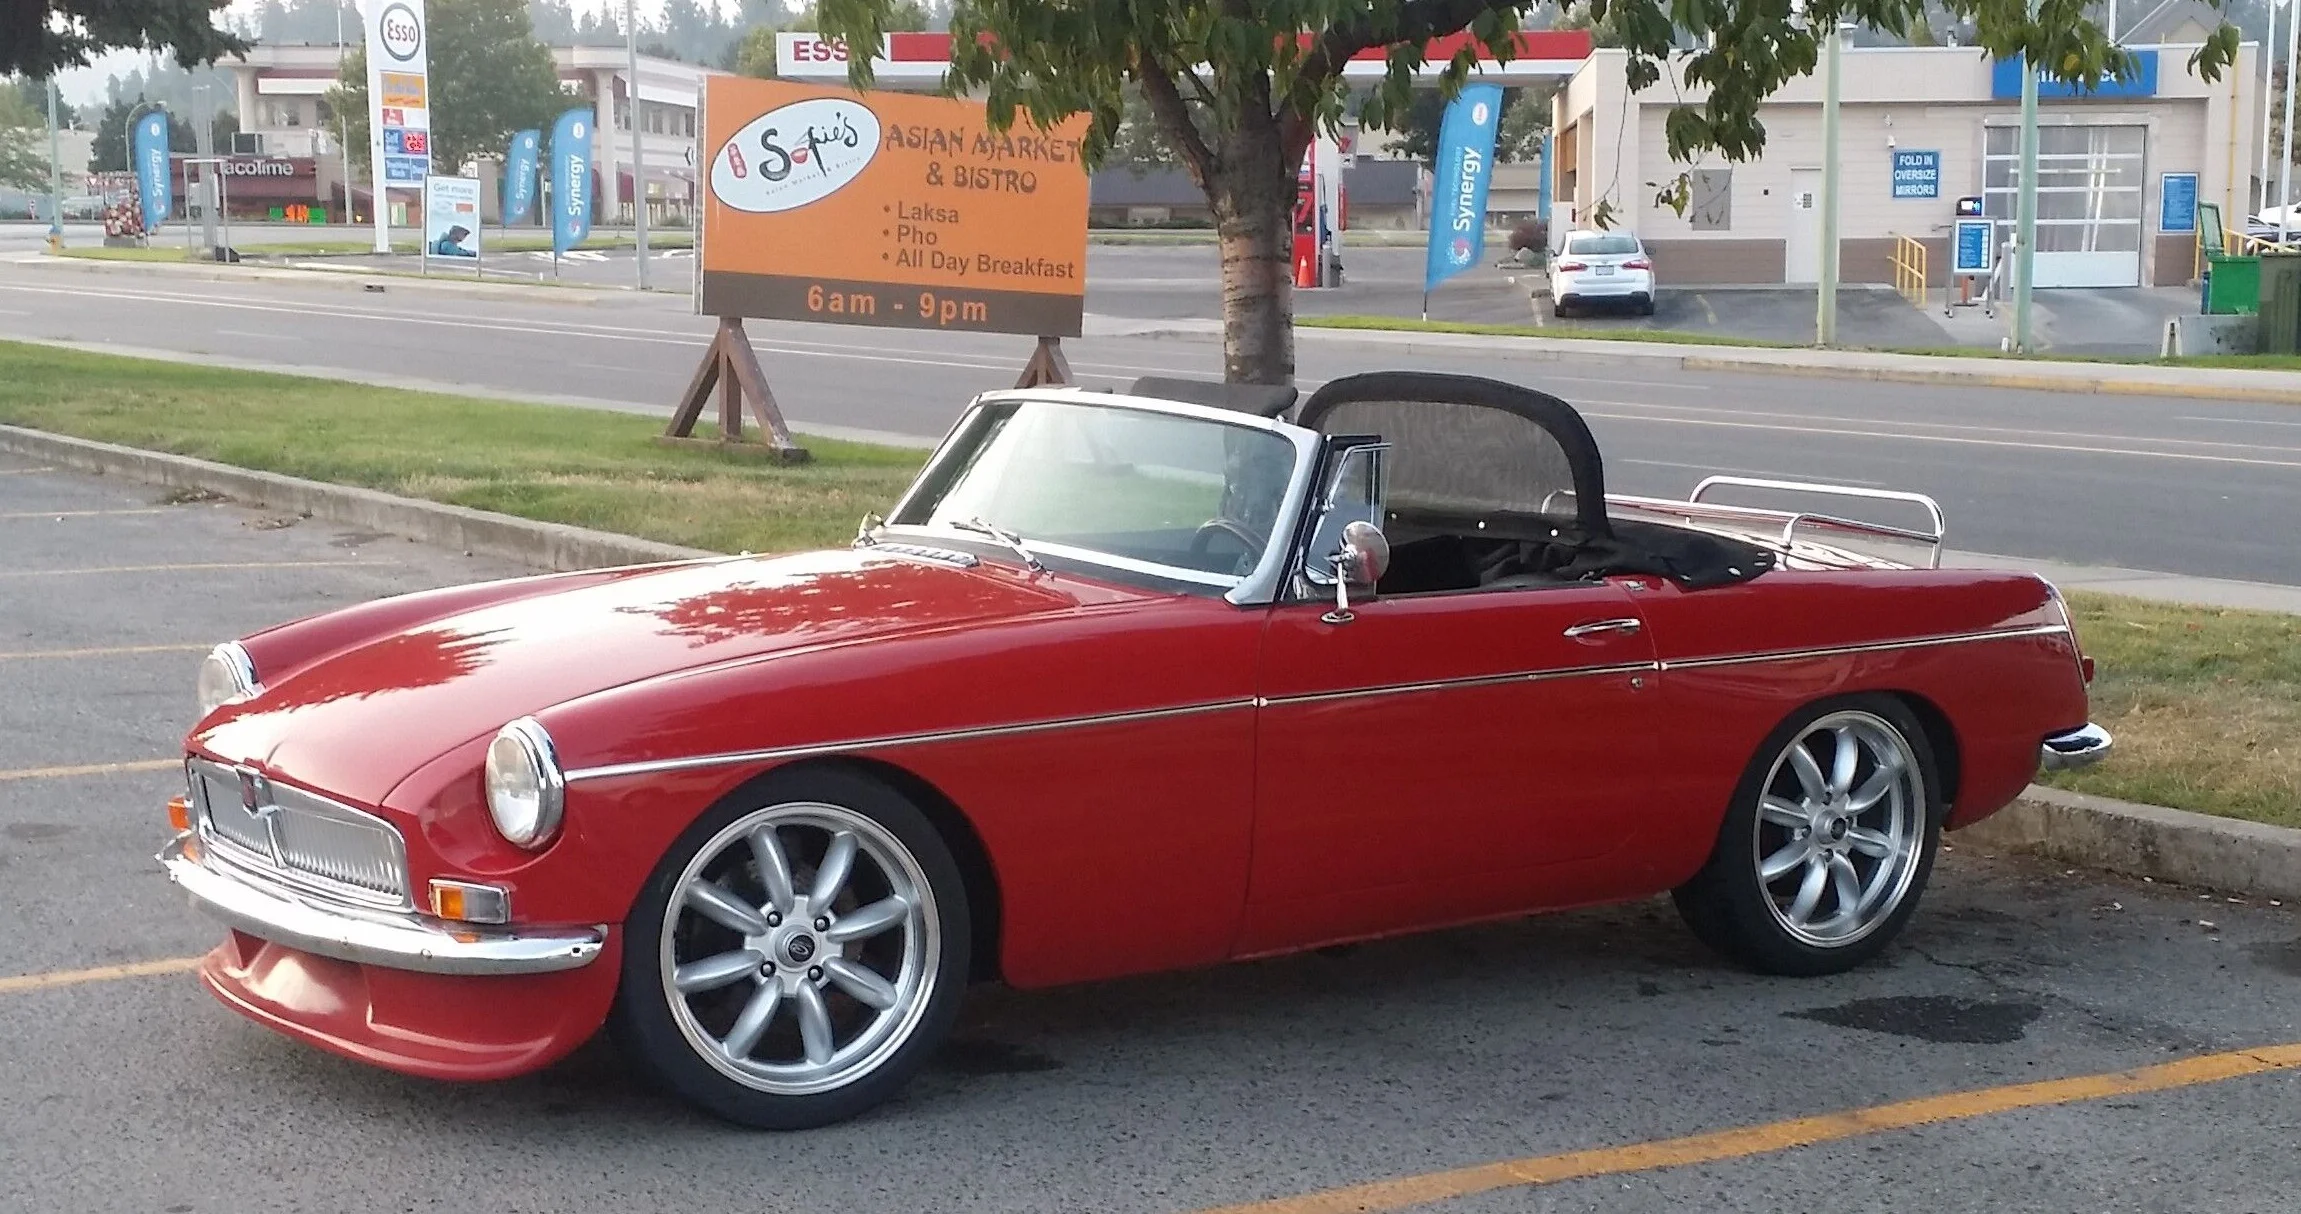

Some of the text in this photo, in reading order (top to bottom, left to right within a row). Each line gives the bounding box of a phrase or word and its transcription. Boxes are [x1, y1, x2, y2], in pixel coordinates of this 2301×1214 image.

[387, 19, 416, 43] Esso
[885, 123, 1082, 163] ASIAN MARKET
[151, 148, 165, 198] Synergy
[1894, 169, 1937, 181] OVERSIZE
[1899, 154, 1933, 166] FOLD IN
[515, 158, 530, 200] Synergy
[568, 154, 585, 216] Synergy
[926, 160, 1038, 194] & BISTRO
[1453, 146, 1482, 232] Synergy
[1895, 184, 1935, 196] MIRRORS
[897, 201, 960, 224] Laksa
[896, 224, 938, 246] Pho
[895, 249, 1075, 280] All Day Breakfast
[807, 284, 876, 316] 6am
[918, 292, 988, 326] 9pm
